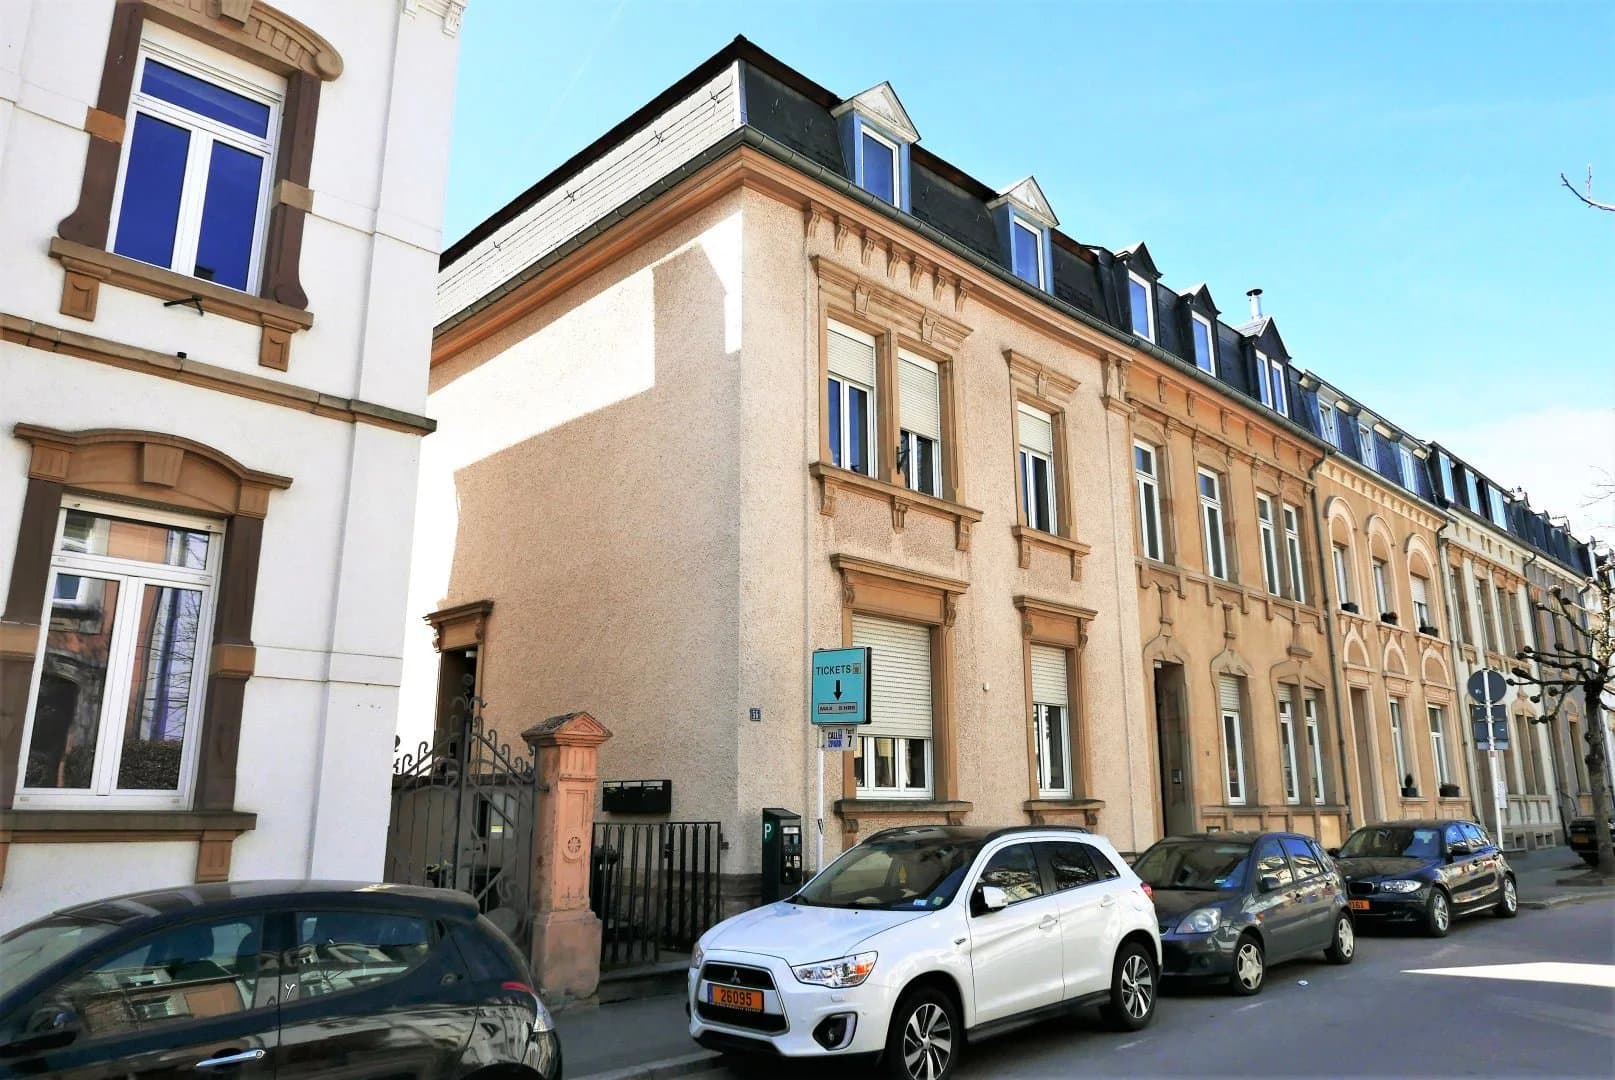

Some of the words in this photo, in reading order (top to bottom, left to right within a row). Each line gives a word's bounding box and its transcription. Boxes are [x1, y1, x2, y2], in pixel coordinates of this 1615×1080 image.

[816, 665, 851, 675] TICKETS
[847, 735, 852, 747] 7
[764, 823, 772, 840] P
[720, 990, 752, 1006] 26095
